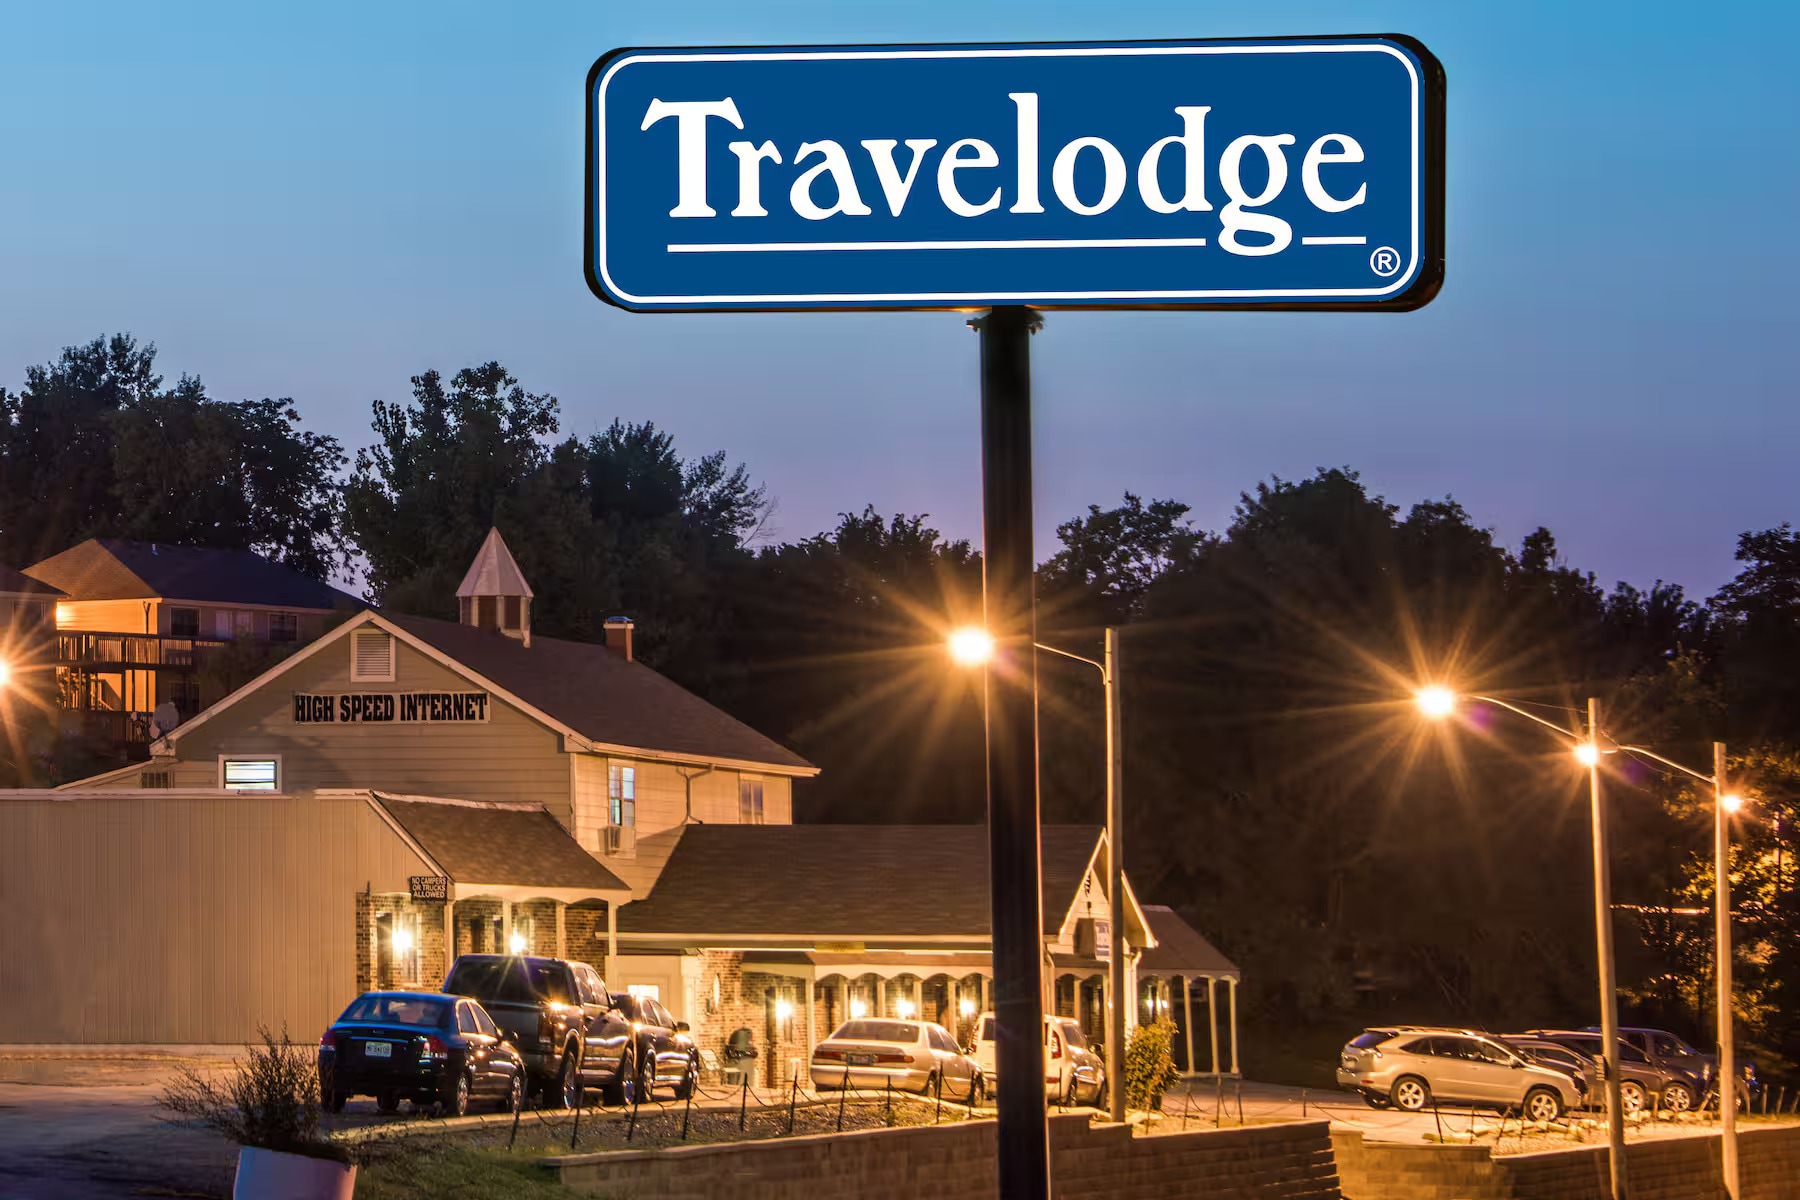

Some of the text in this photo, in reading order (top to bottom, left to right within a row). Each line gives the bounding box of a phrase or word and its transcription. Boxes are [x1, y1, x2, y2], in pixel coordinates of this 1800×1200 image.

[641, 92, 1366, 257] Travelodge
[295, 693, 488, 722] HIGH SPEED INTERNET
[411, 877, 447, 885] NO CAMPERS
